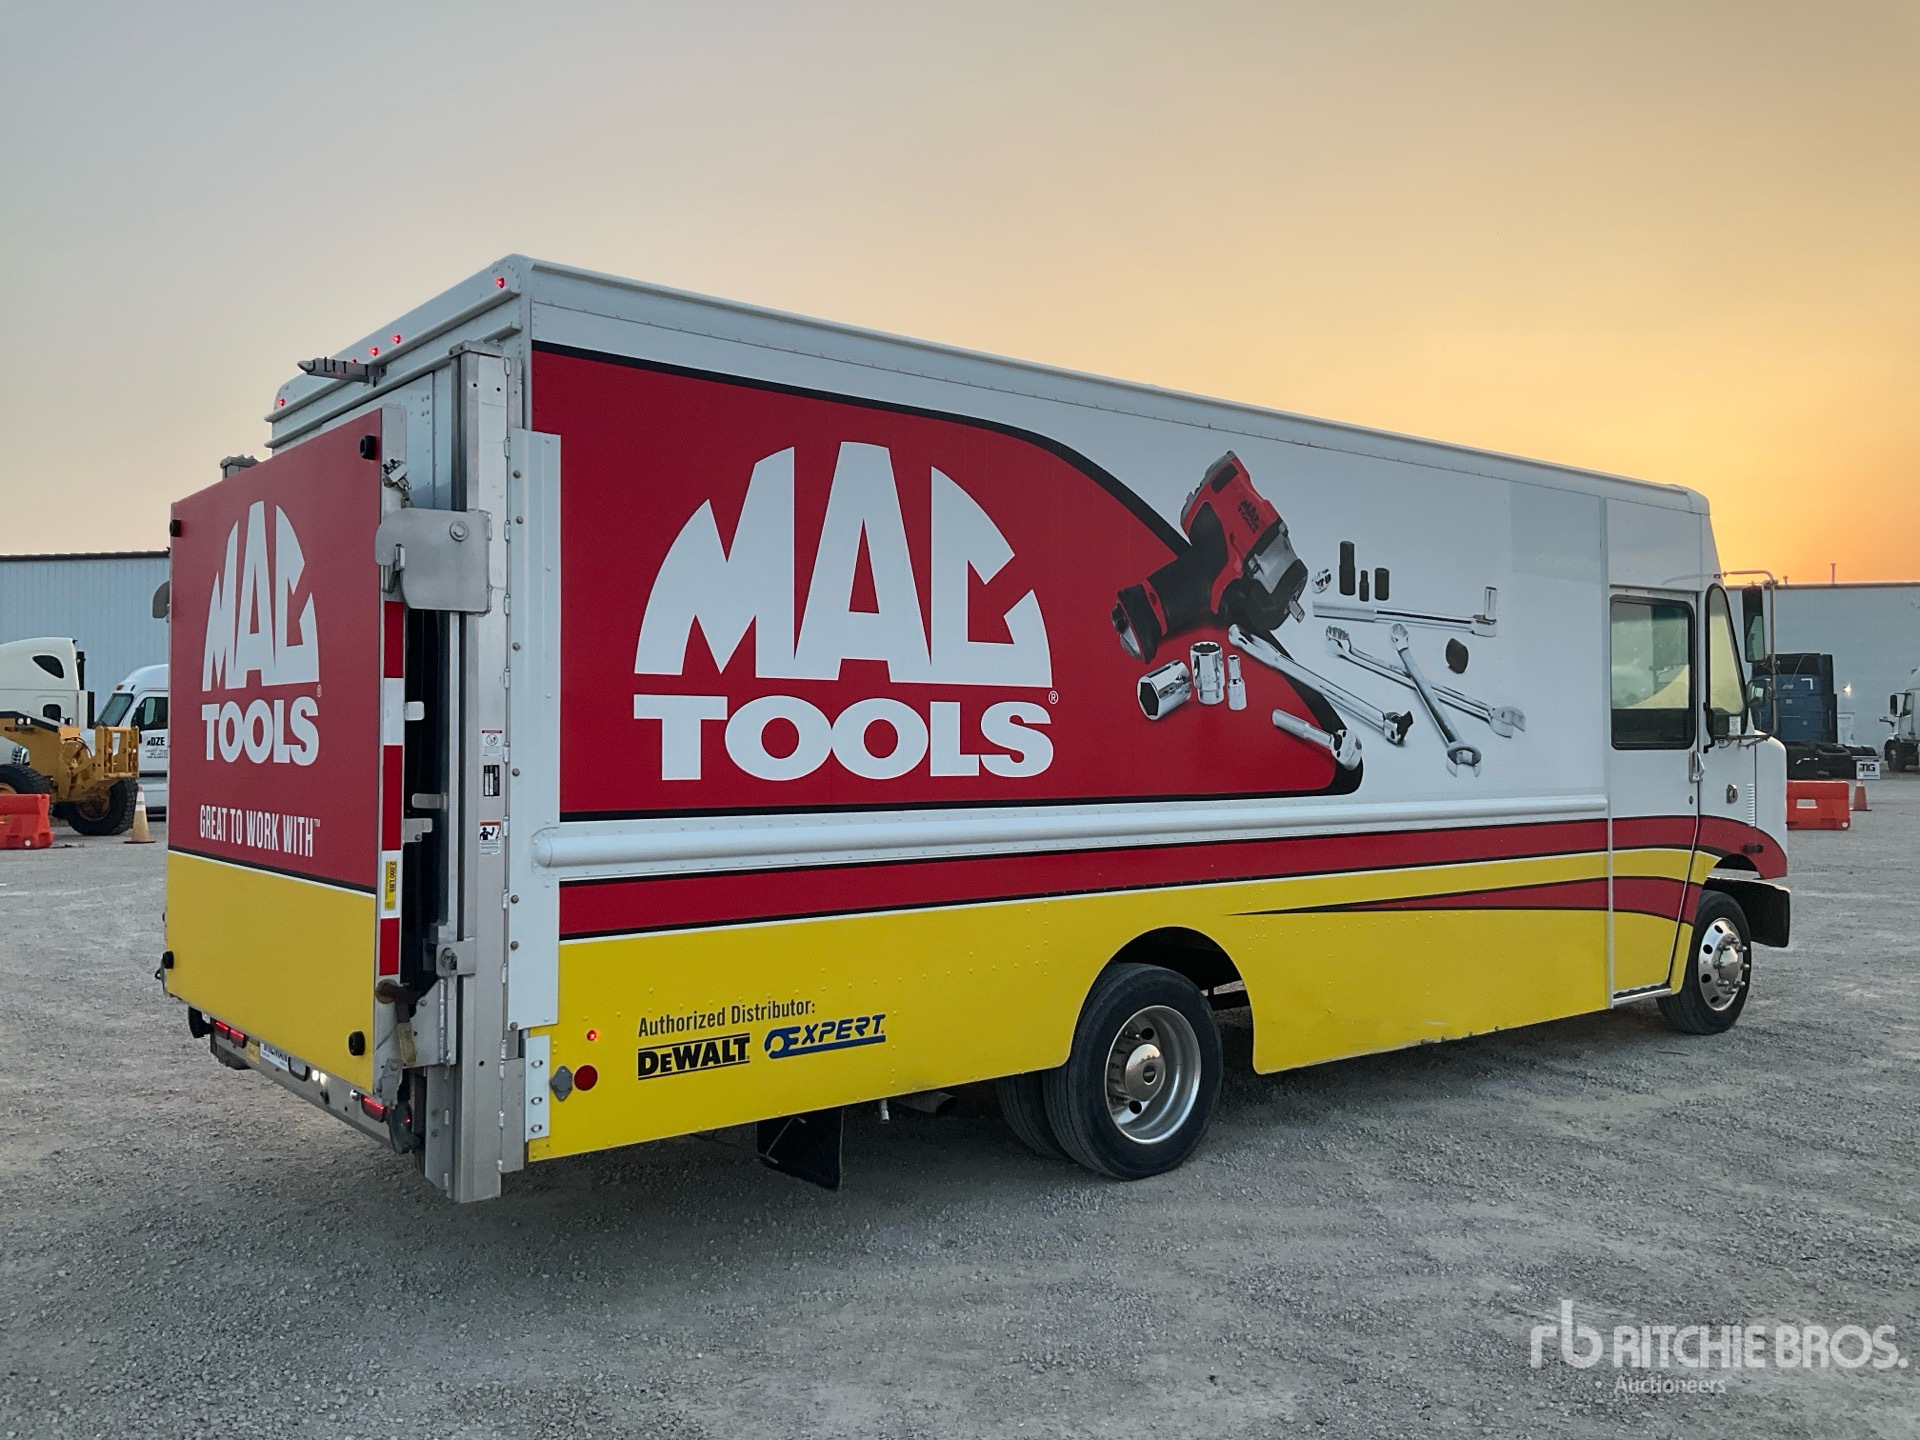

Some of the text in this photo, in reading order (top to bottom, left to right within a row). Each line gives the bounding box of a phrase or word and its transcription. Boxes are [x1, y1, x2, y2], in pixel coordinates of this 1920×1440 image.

[202, 500, 320, 692] MAC
[634, 441, 1053, 688] MAC
[201, 696, 320, 767] TOOLS
[633, 694, 1054, 780] TOOLS
[200, 804, 227, 842] GREAT
[230, 808, 243, 845] TO
[246, 810, 279, 851] WORK
[638, 999, 816, 1038] Authorized Distributor:
